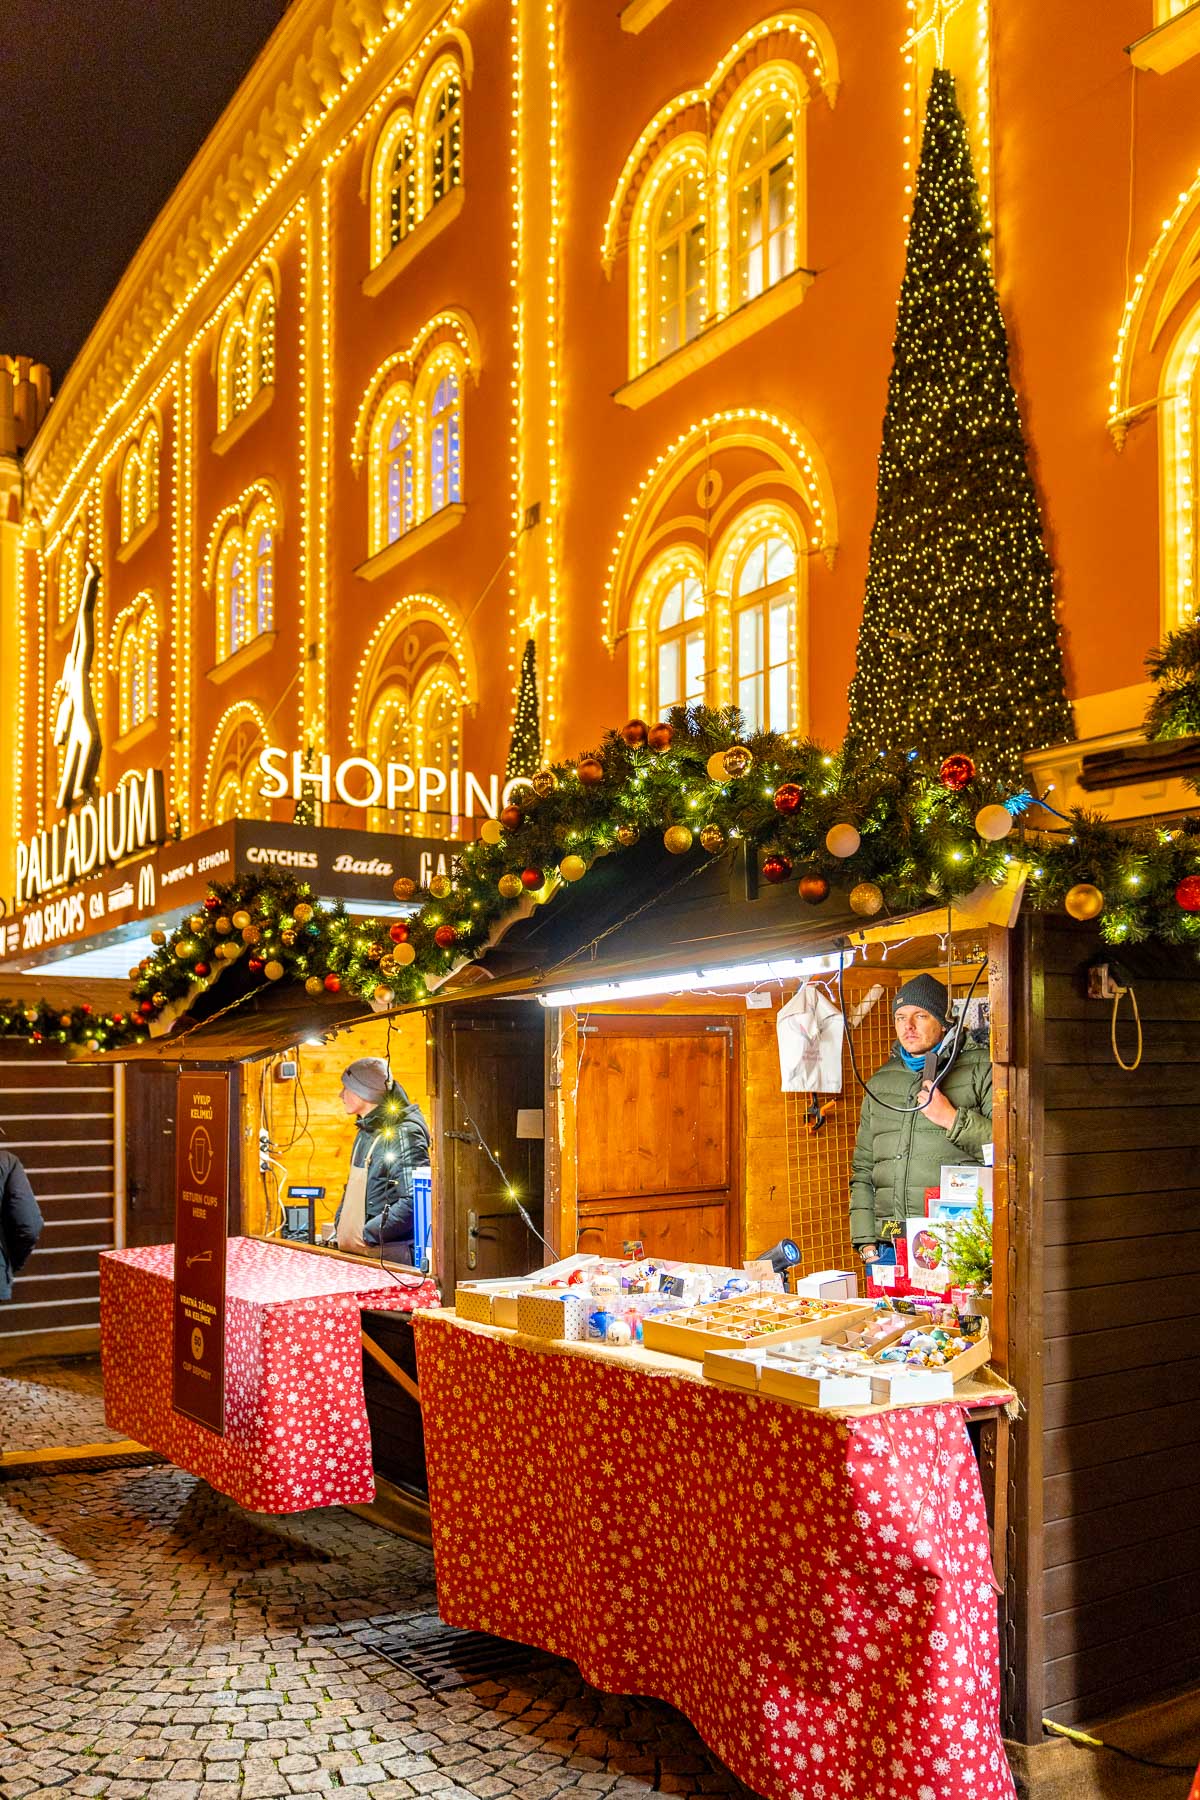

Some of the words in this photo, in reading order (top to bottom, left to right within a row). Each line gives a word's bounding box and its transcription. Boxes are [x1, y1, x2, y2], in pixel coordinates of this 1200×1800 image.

[16, 767, 157, 907] PALLADIUM
[246, 847, 318, 868] CATCHES
[332, 854, 394, 876] Bata
[22, 909, 44, 950] 200
[44, 891, 85, 942] SHOPS
[182, 1190, 203, 1204] RETURN
[203, 1194, 218, 1208] CUPS
[192, 1207, 207, 1219] HERE
